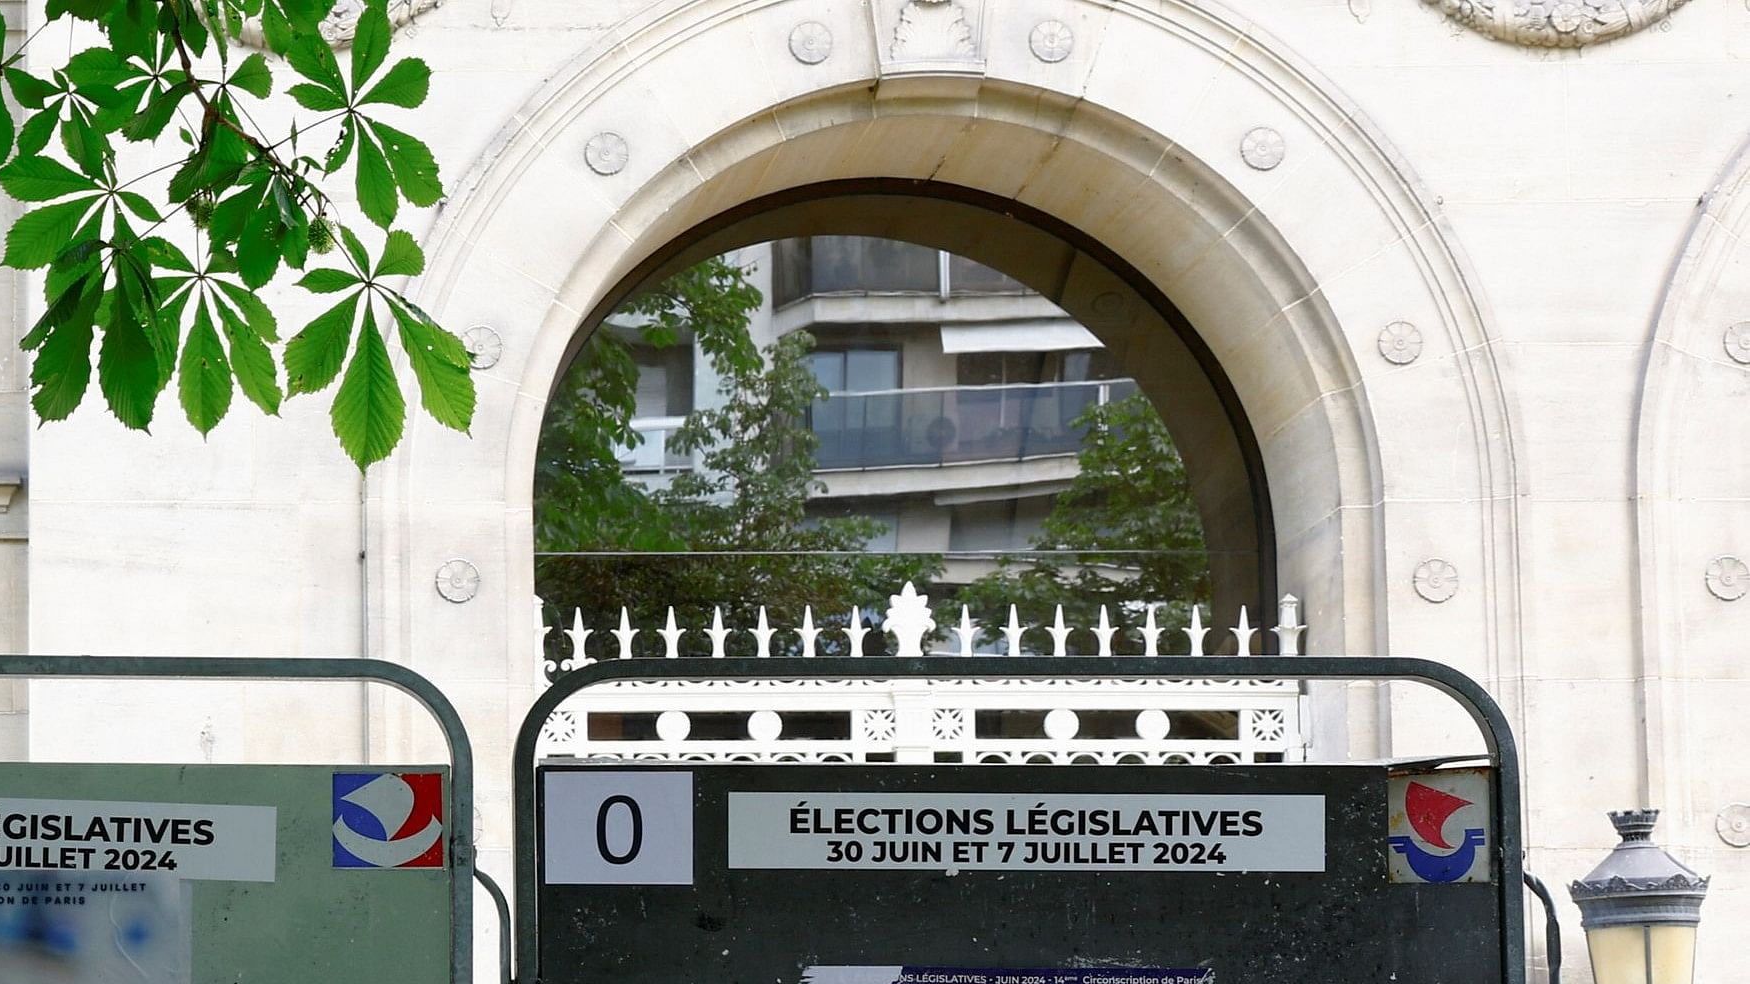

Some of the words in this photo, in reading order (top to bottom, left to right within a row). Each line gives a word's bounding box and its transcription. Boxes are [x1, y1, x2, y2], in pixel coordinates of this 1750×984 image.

[596, 795, 643, 865] 0
[789, 801, 995, 836] ÉLECTIONS
[1006, 802, 1264, 837] LÉGISLATIVES
[104, 848, 178, 872] 2024
[826, 841, 864, 863] 30
[871, 841, 942, 864] JUIN
[953, 842, 989, 863] ET
[997, 842, 1015, 863] 7
[1023, 842, 1145, 864] JUILLET
[1153, 842, 1227, 865] 2024
[17, 883, 49, 892] JUIN
[56, 883, 70, 892] ET
[78, 883, 85, 892] 7
[91, 883, 147, 893] JUILLET
[22, 896, 38, 905] DE
[45, 896, 86, 905] PARIS
[916, 973, 987, 984] LÉGISLATIVES
[995, 976, 1020, 984] JUIN
[1021, 976, 1046, 984] 2024
[1161, 976, 1174, 984] de
